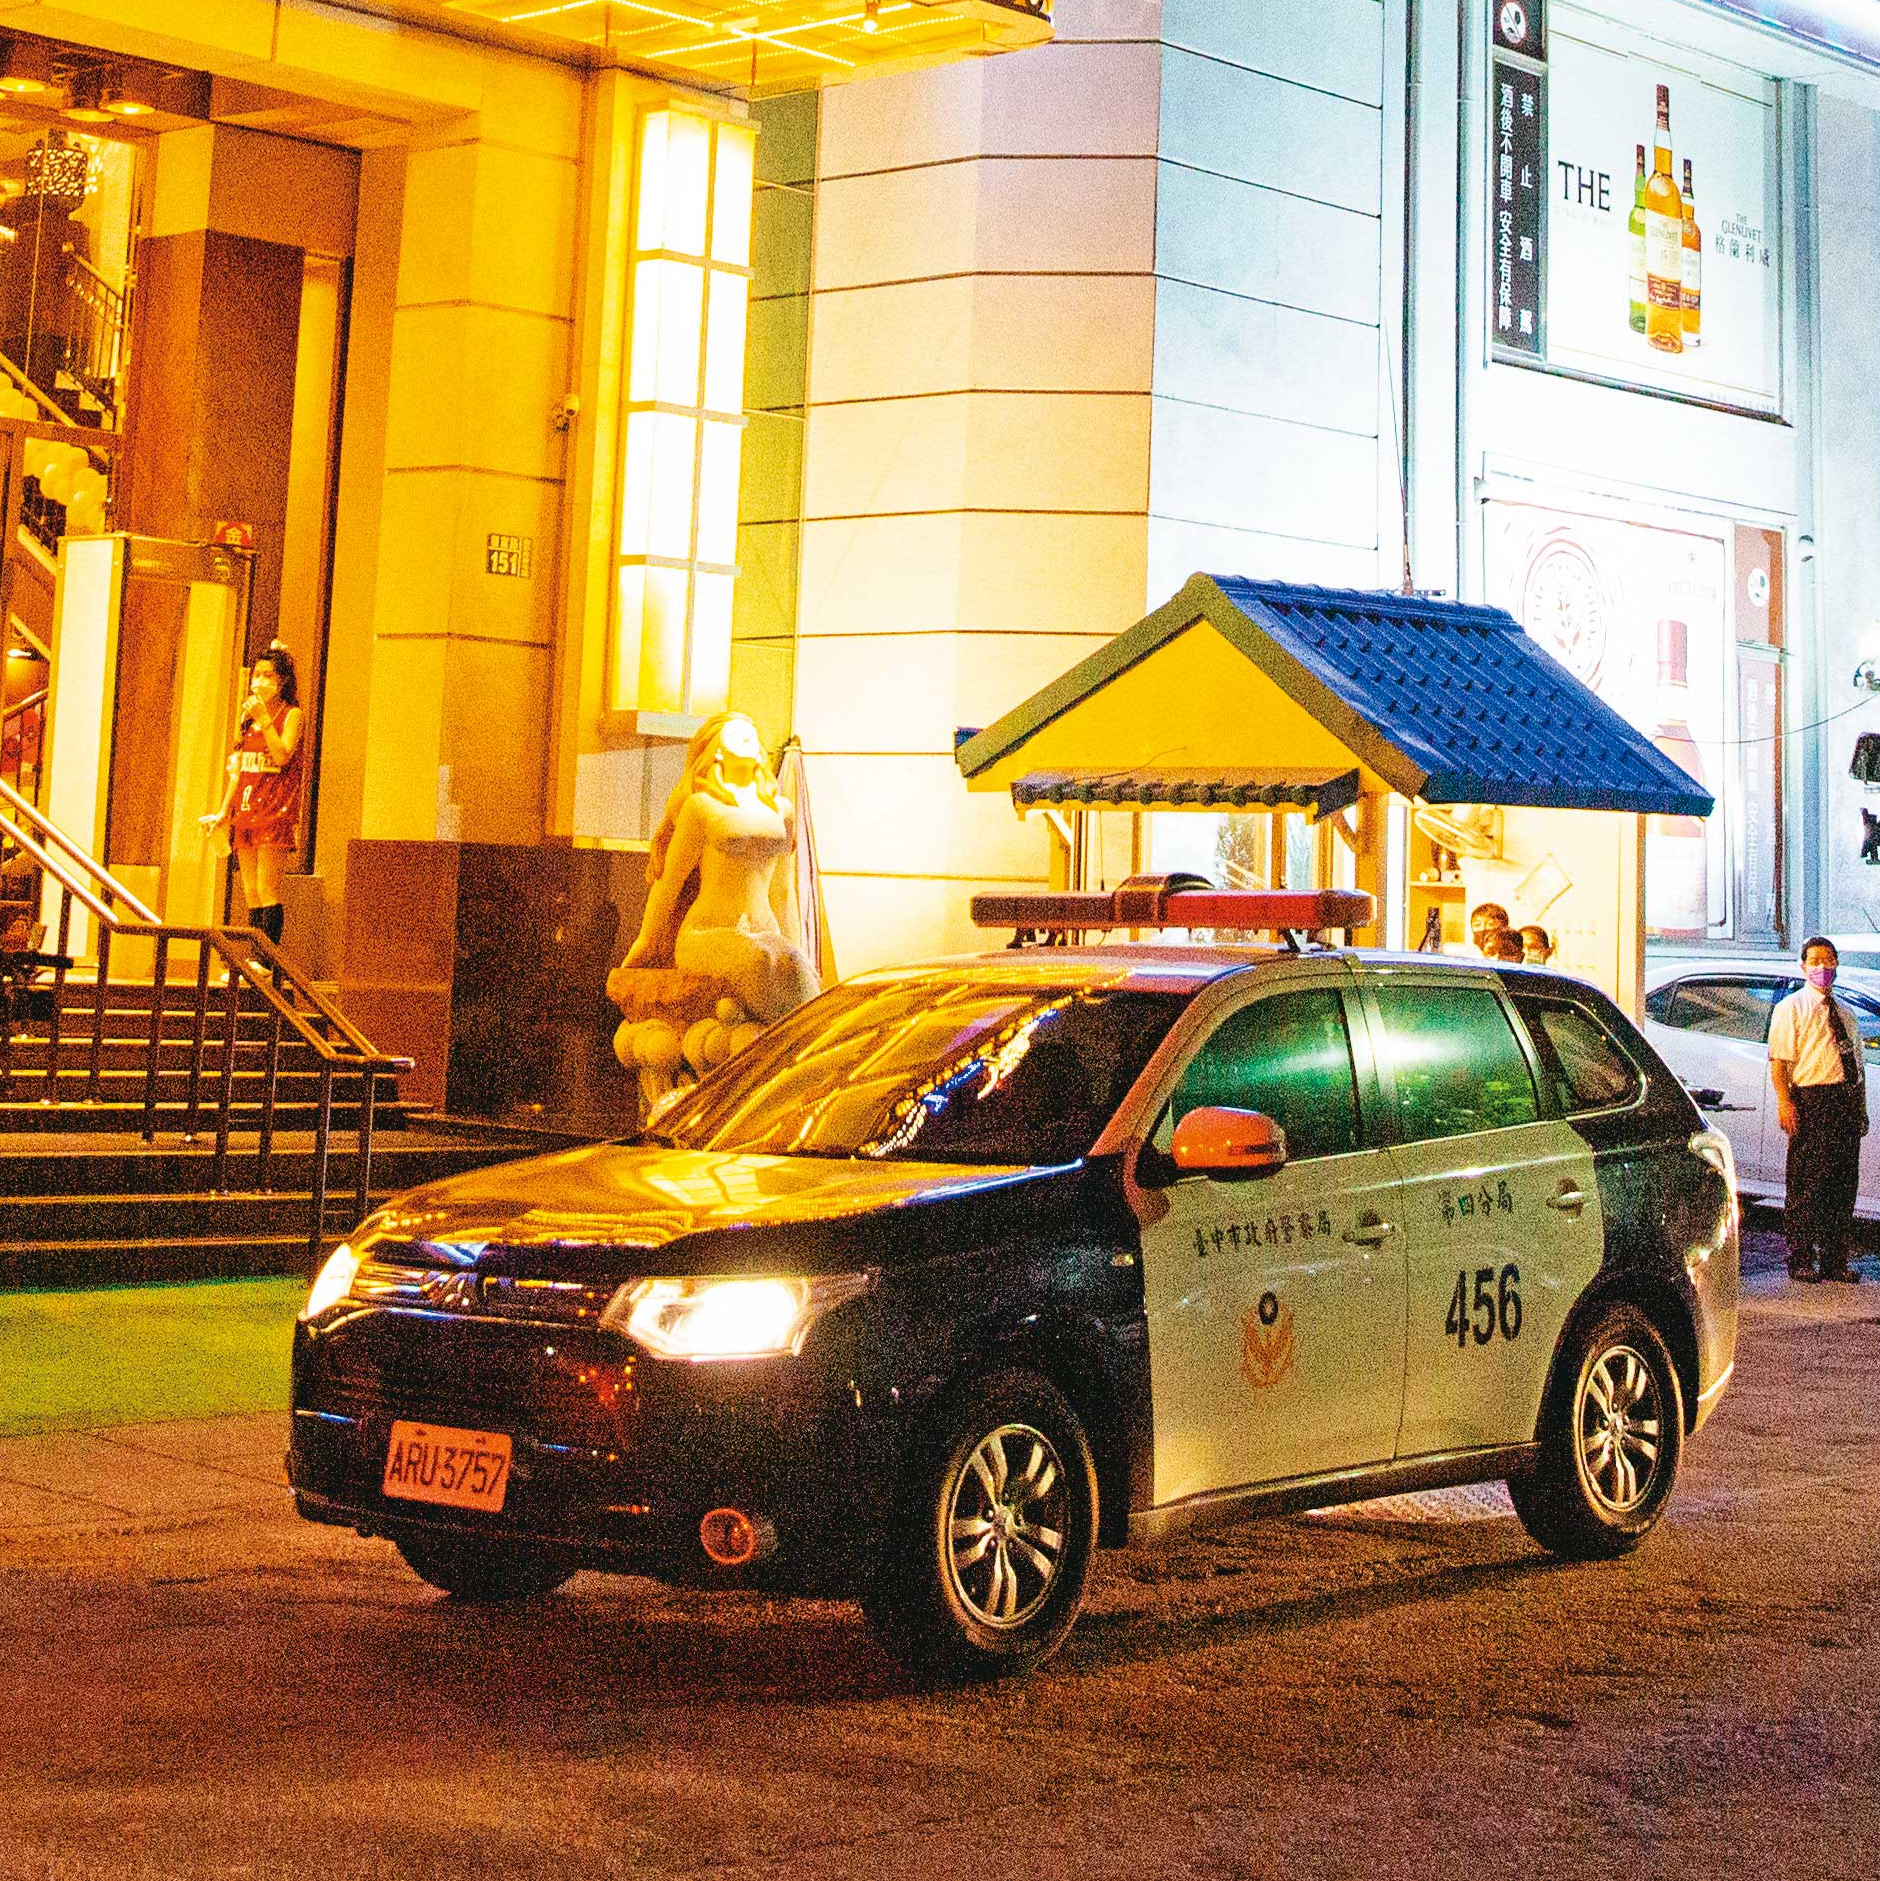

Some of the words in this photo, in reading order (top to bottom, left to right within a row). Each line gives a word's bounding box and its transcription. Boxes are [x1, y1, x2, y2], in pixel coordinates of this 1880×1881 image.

[1557, 159, 1611, 212] THE
[1721, 219, 1762, 243] GLENLIVET
[490, 550, 518, 575] 151
[1444, 1261, 1523, 1348] 456
